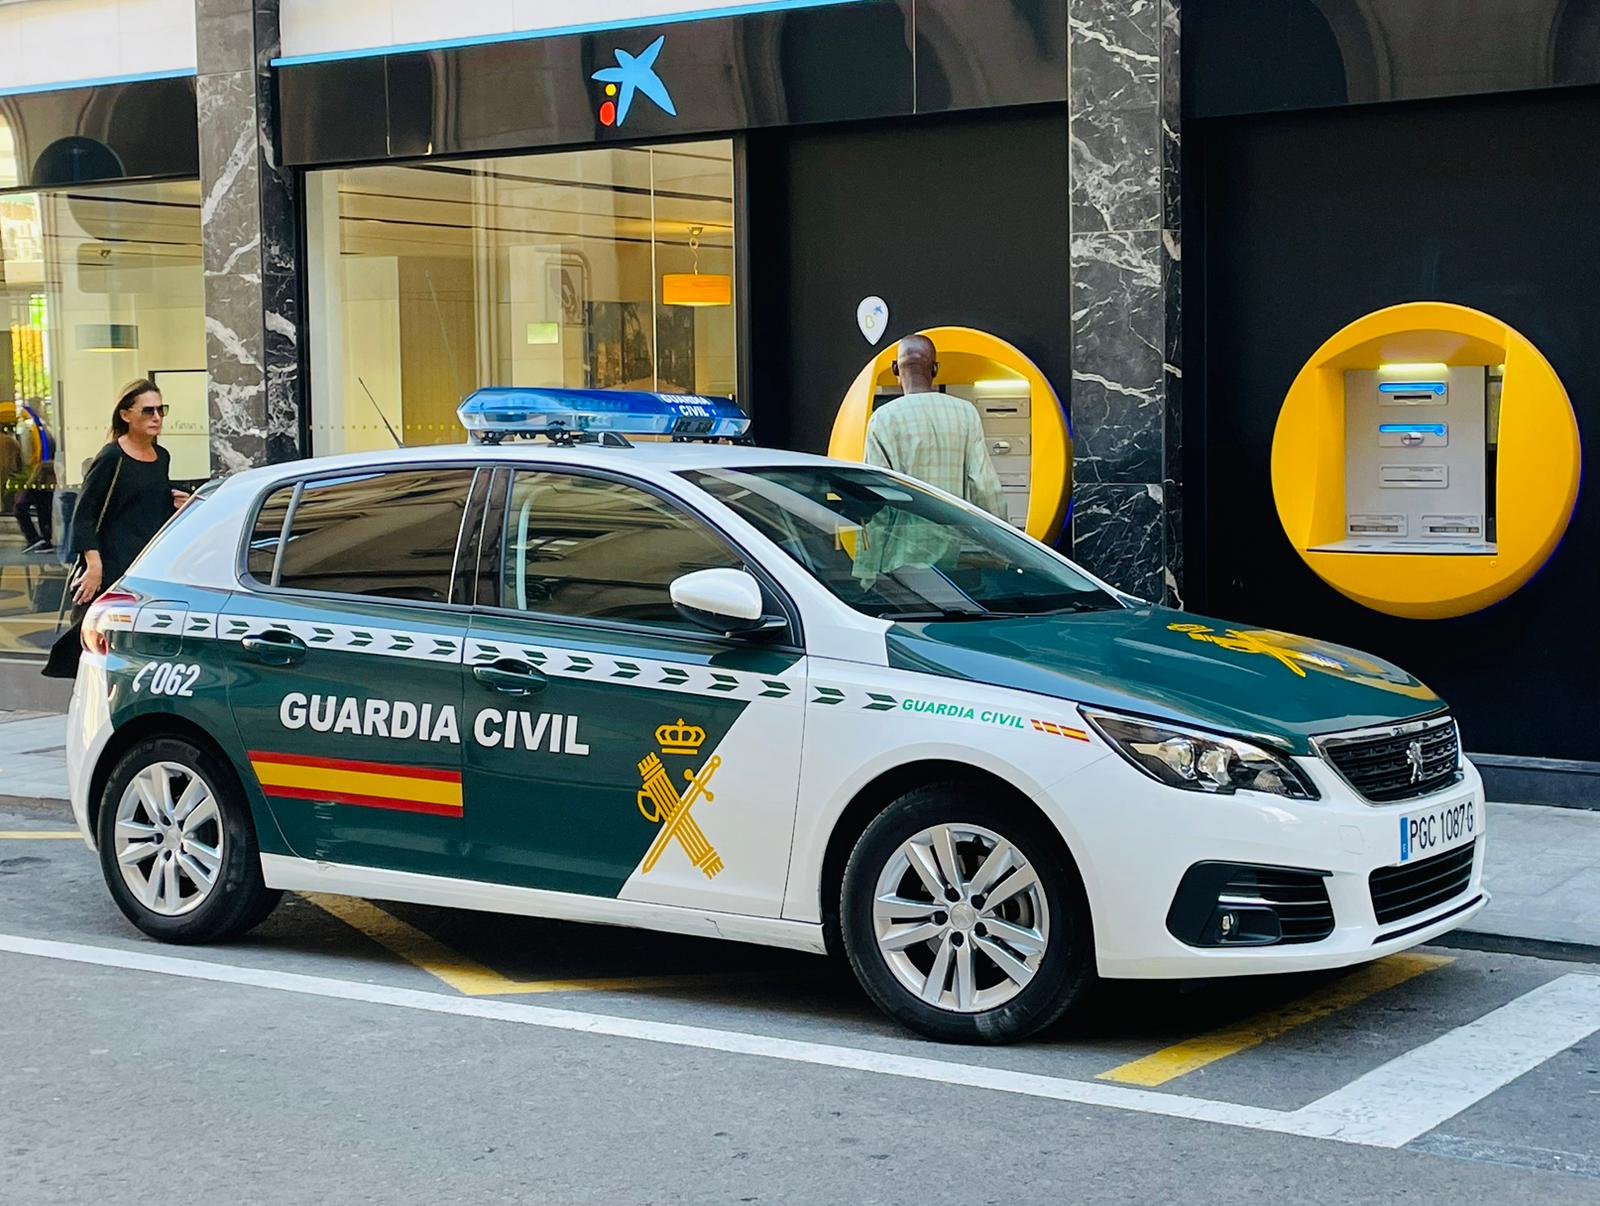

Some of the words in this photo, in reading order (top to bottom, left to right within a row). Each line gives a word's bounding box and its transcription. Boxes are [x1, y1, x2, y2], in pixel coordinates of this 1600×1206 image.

[660, 394, 711, 405] GUARDIA
[679, 405, 709, 417] CIVIL
[149, 663, 201, 698] 062
[279, 692, 461, 744] GUARDIA
[473, 707, 590, 756] CIVIL
[902, 698, 975, 720] GUARDIA
[981, 711, 1025, 729] CIVIL
[1410, 815, 1436, 853] PGC
